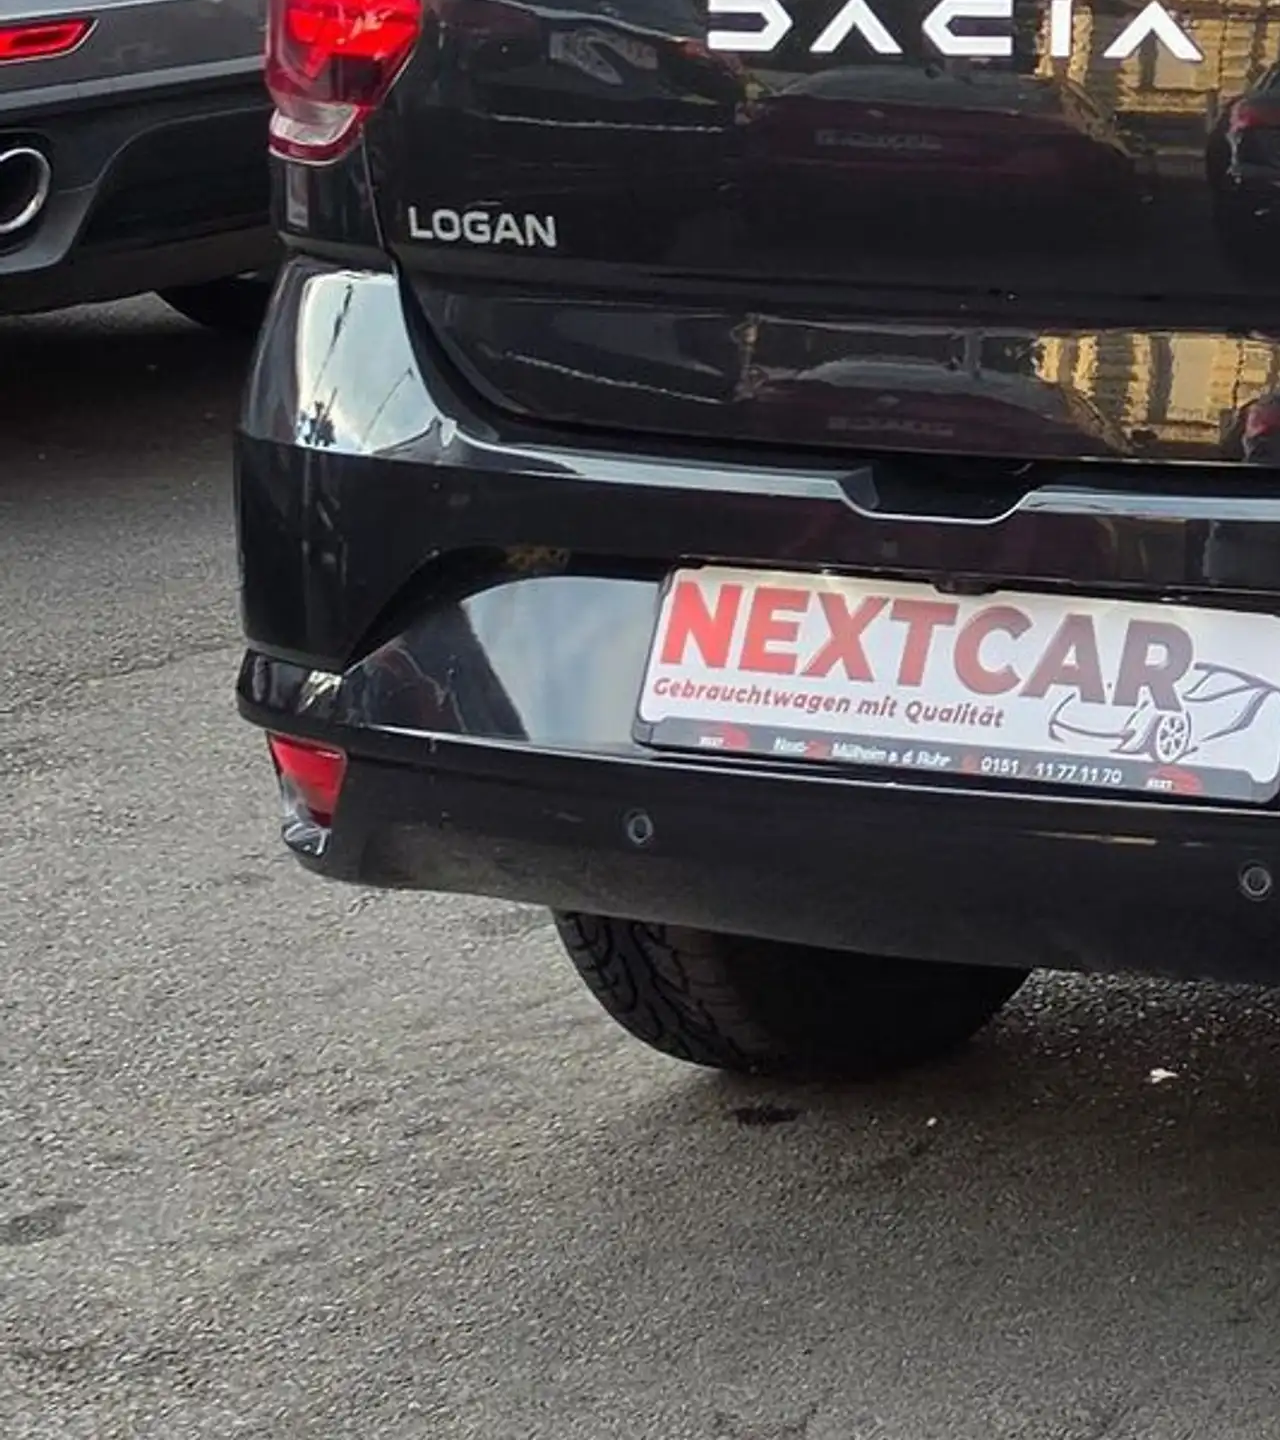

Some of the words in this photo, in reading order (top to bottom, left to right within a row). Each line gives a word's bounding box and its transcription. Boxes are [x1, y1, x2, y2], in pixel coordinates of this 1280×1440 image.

[408, 205, 557, 248] LOGAN
[658, 579, 1194, 712] NEXTCAR
[653, 677, 851, 714] Gebrauchtwagen
[857, 696, 898, 718] mit
[904, 700, 1005, 729] Qualität
[980, 756, 1019, 774] 0151
